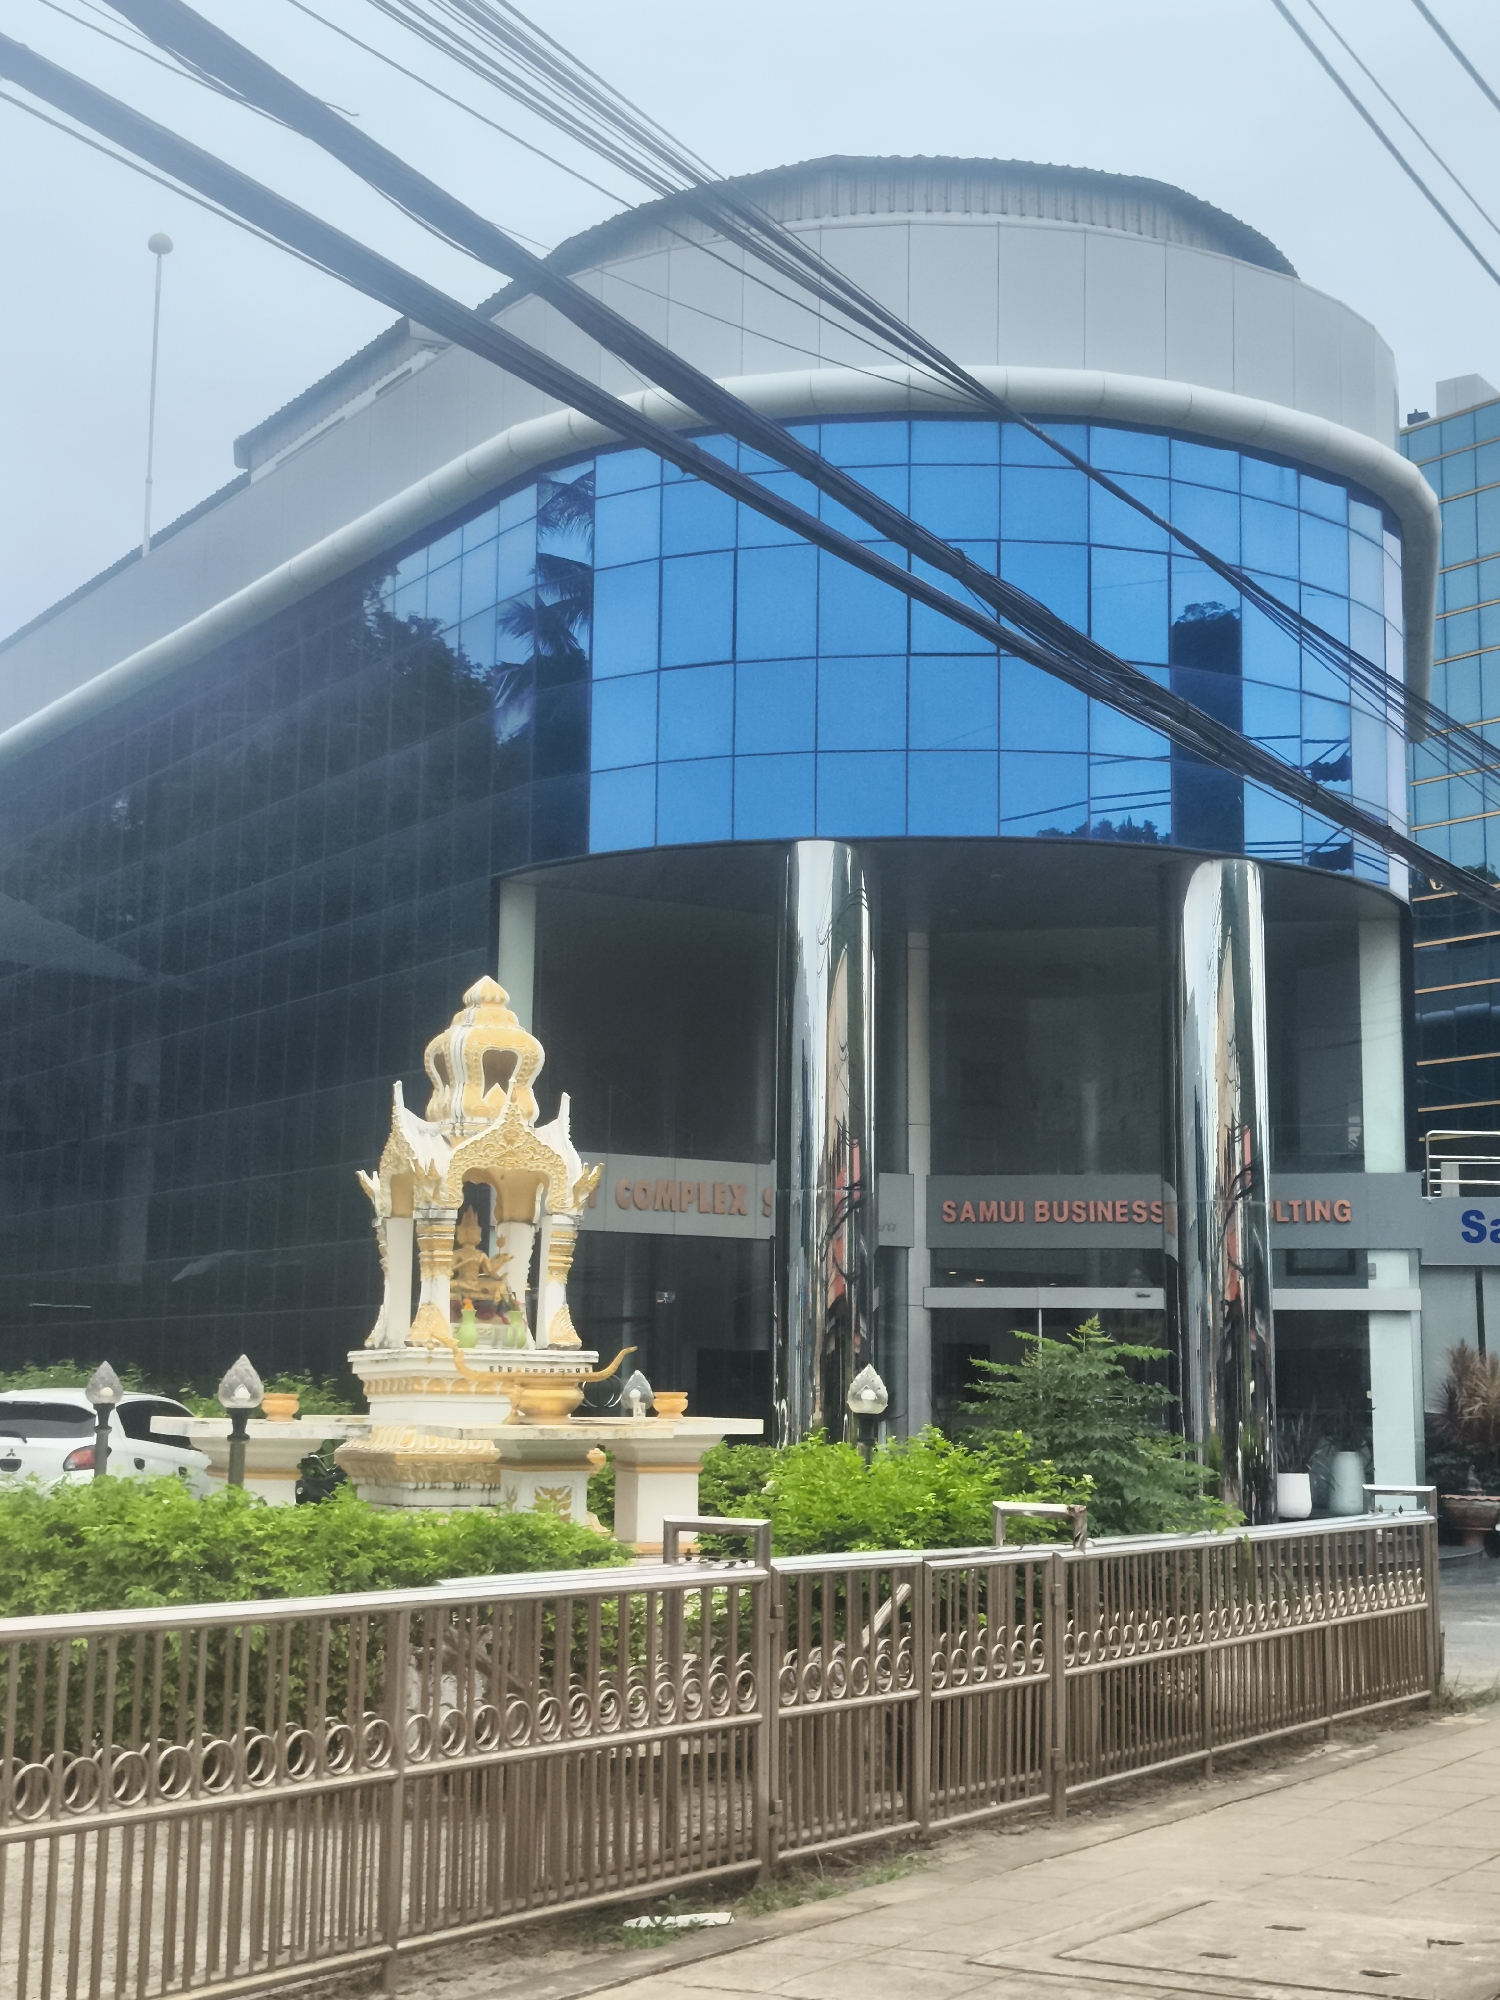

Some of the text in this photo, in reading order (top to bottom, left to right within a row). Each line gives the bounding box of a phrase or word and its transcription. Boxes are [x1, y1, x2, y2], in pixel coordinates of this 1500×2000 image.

[615, 1178, 748, 1216] COMPLEX
[941, 1199, 1352, 1223] SAMUI BUSINESS LTING
